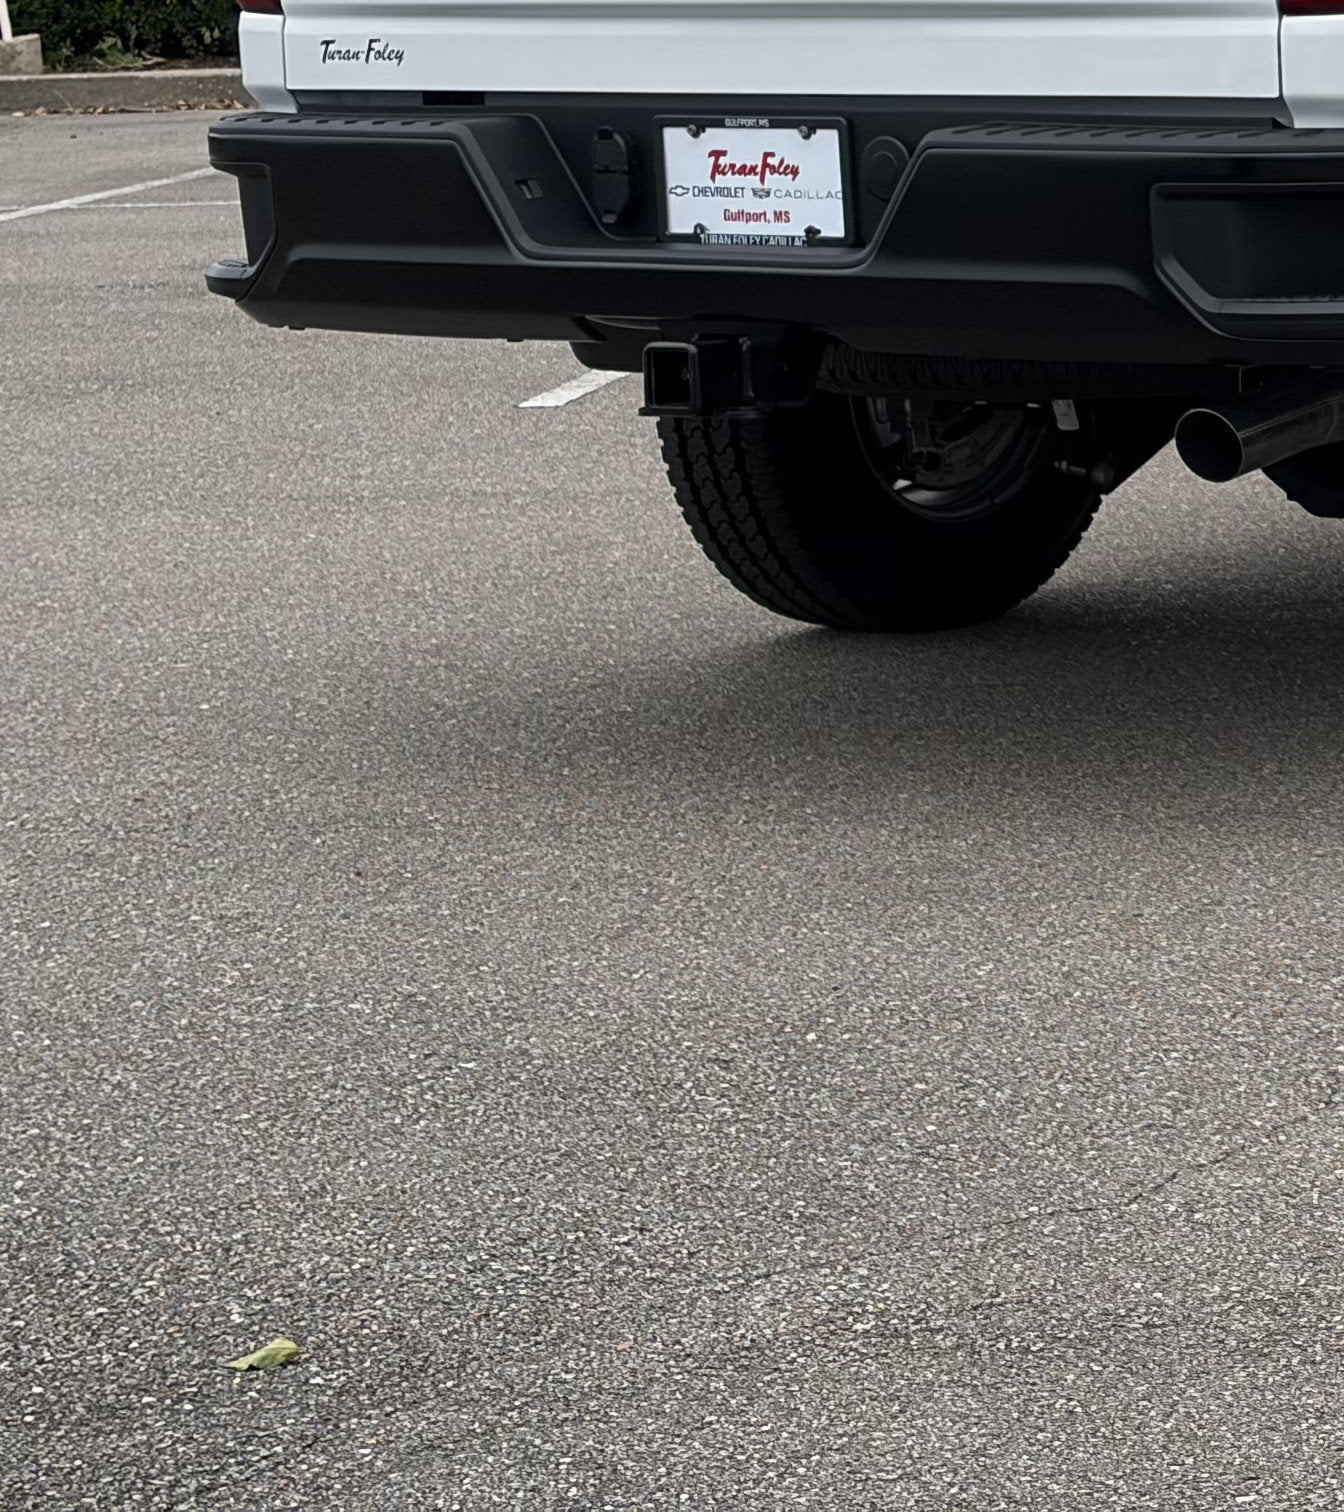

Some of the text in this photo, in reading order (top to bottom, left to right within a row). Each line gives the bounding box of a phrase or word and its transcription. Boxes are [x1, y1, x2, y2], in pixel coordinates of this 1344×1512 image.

[691, 186, 844, 200] CHEVROLET CADILLAC
[723, 208, 791, 225] Gulfport, MS
